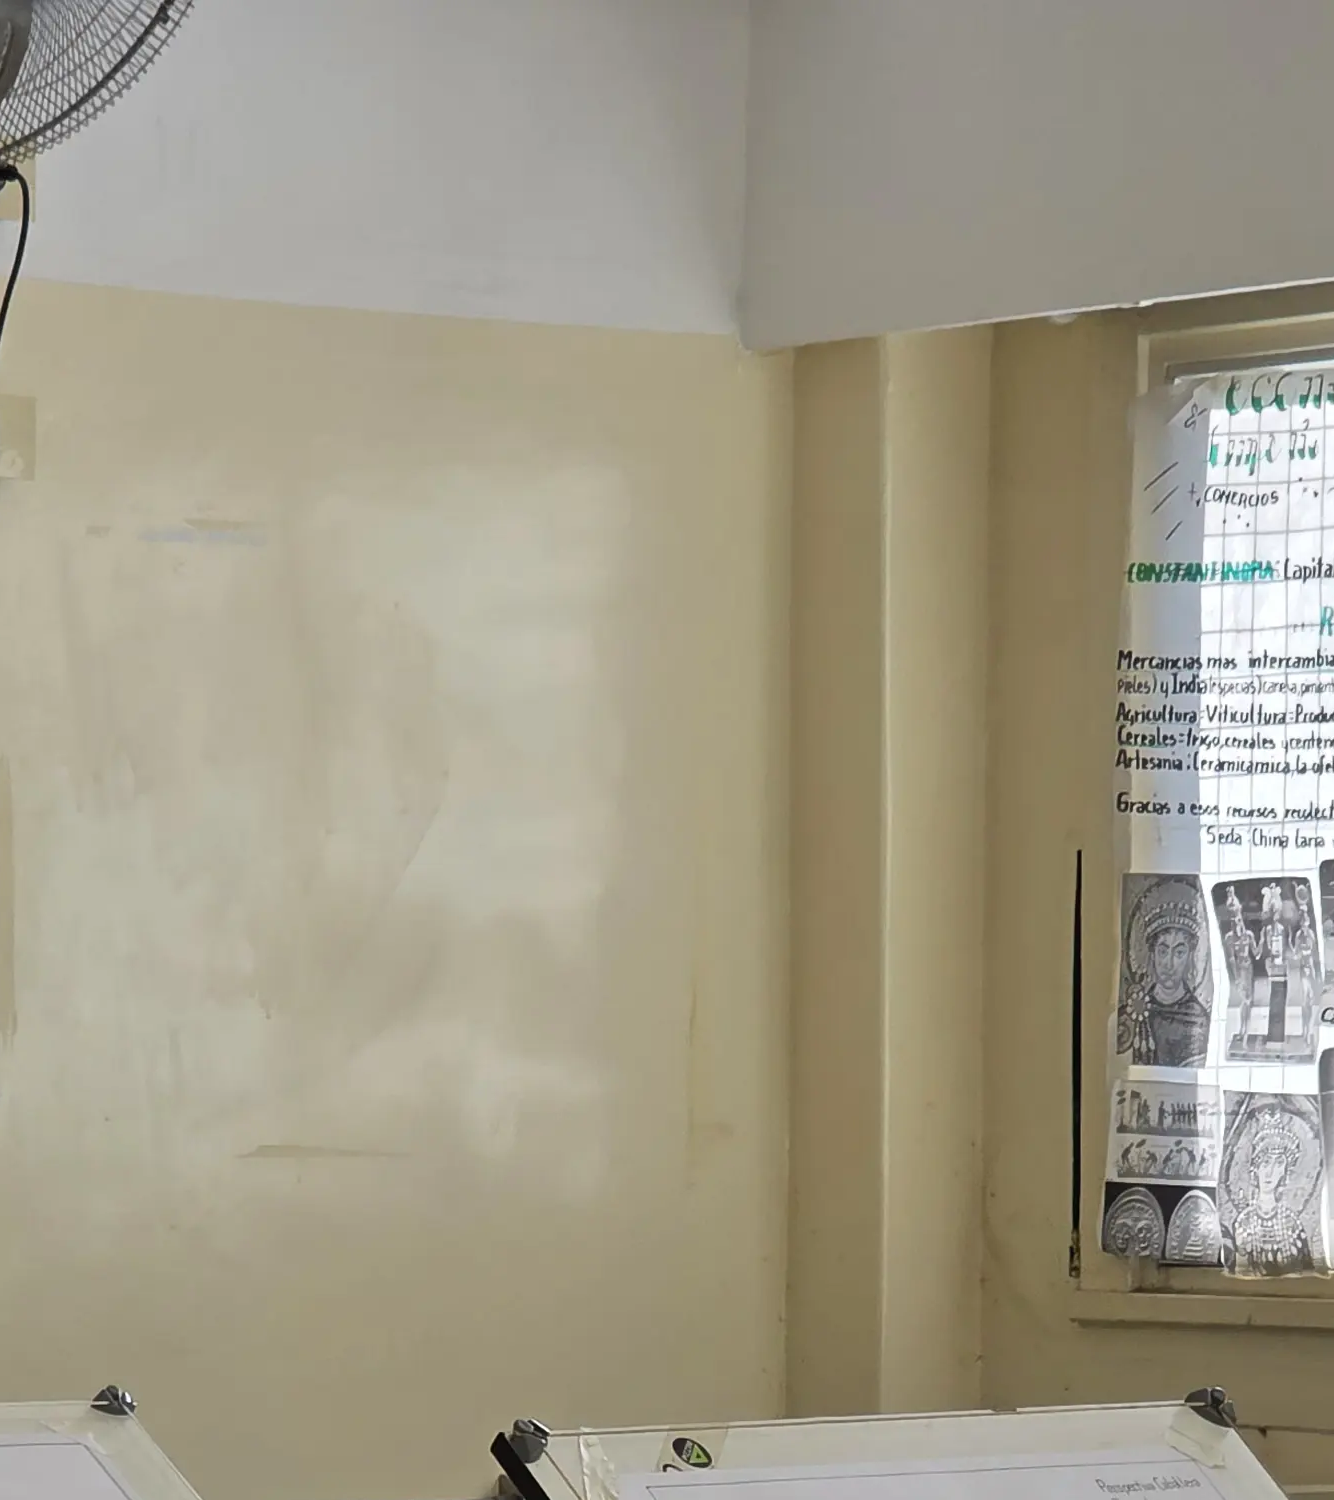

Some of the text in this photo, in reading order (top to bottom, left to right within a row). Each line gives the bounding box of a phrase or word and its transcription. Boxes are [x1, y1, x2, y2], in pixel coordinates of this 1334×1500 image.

[1204, 485, 1280, 508] COMERCIOS
[1116, 791, 1172, 815] Gracias
[1176, 802, 1186, 815] a
[1225, 805, 1279, 820] recursos
